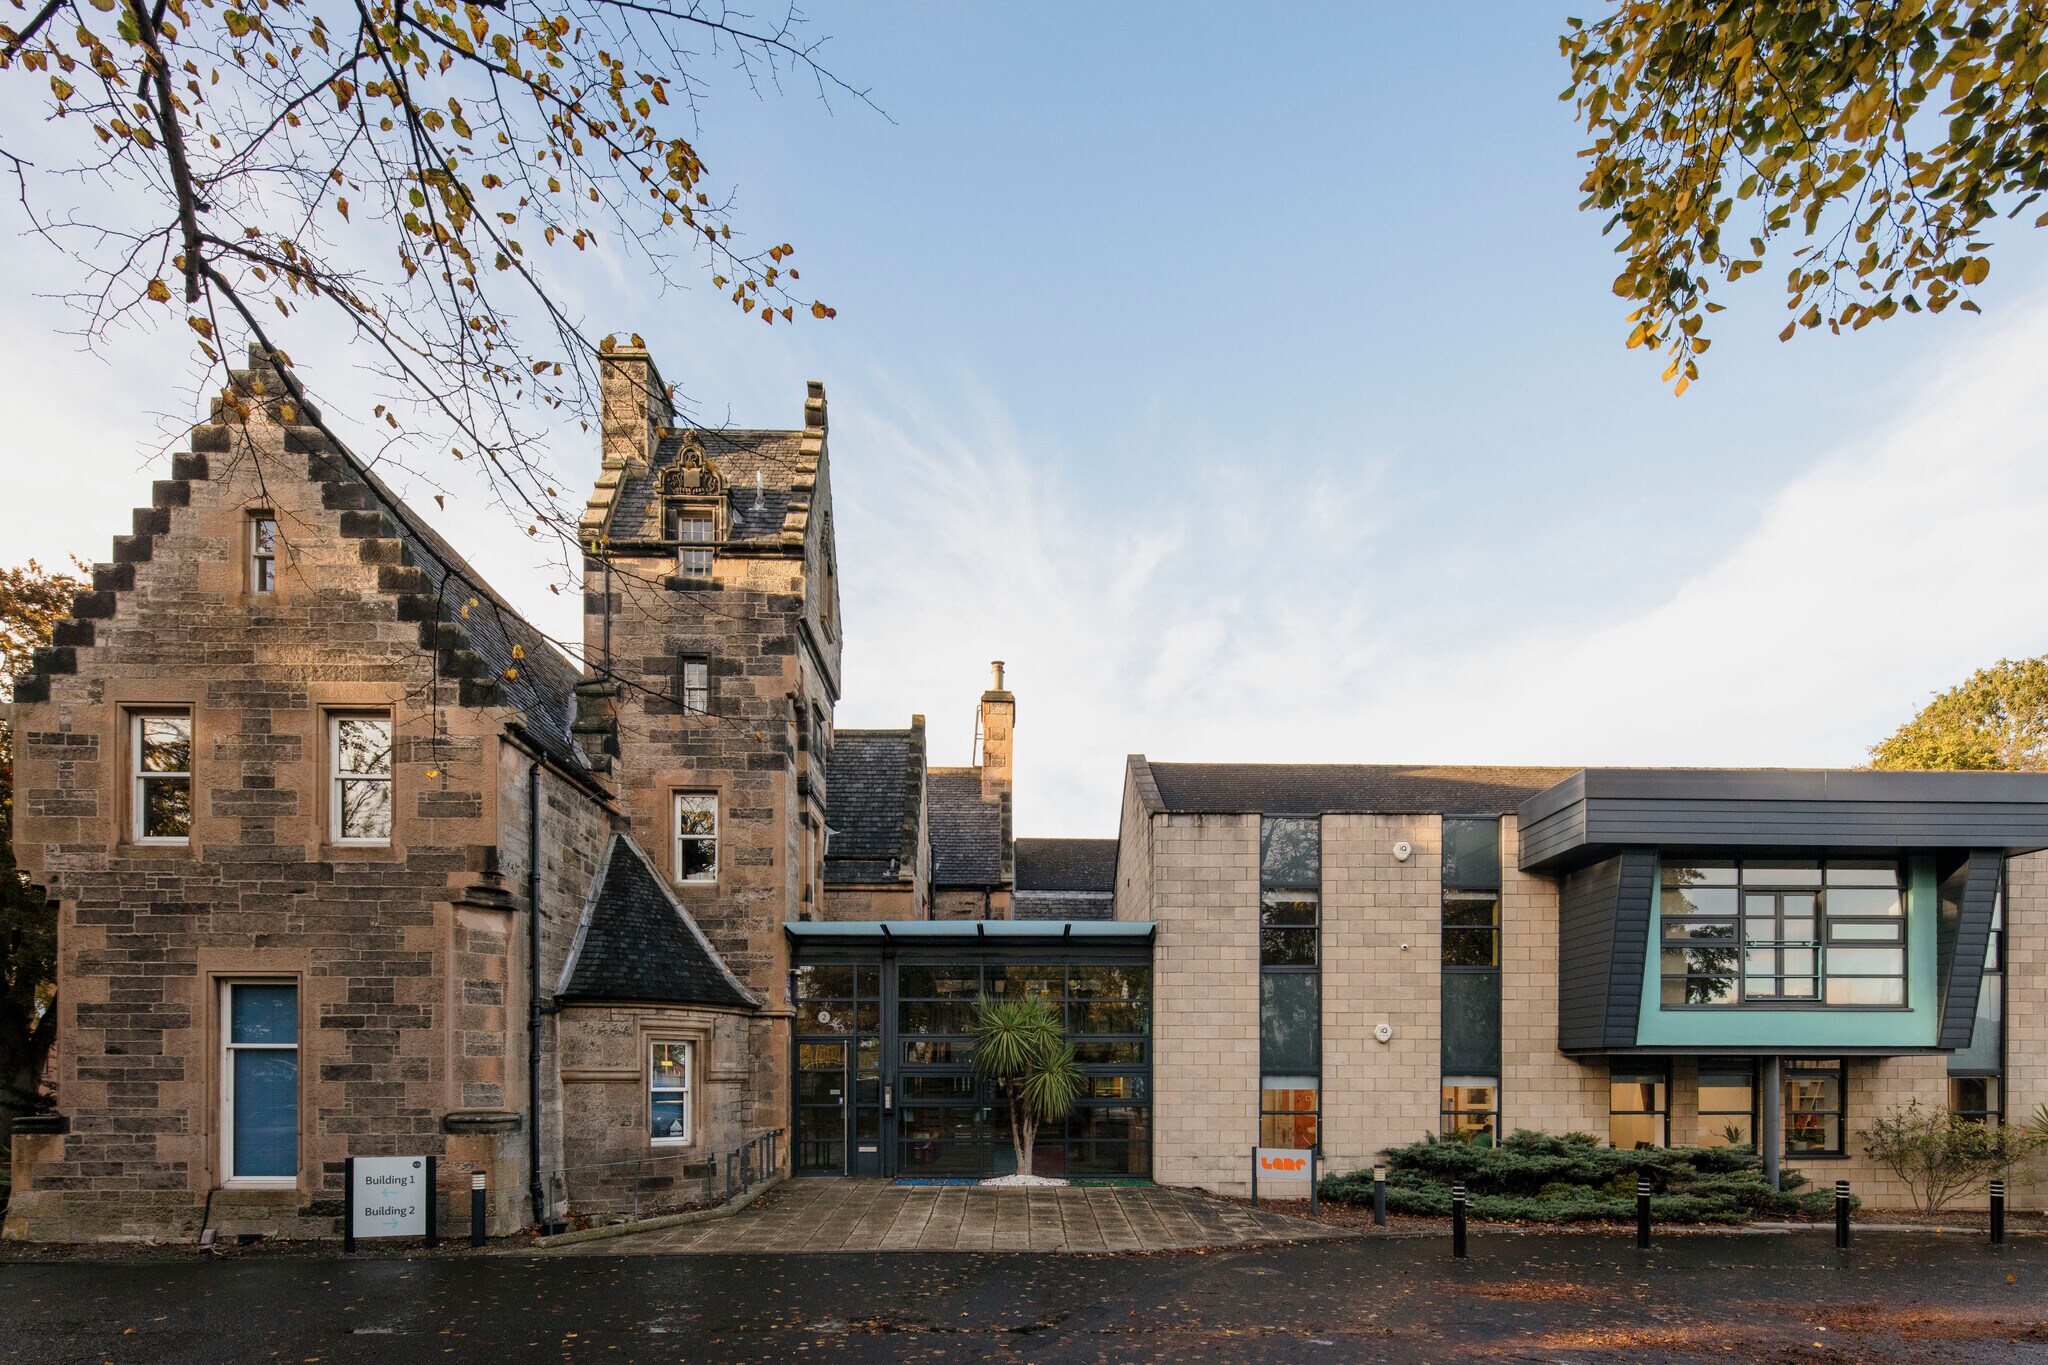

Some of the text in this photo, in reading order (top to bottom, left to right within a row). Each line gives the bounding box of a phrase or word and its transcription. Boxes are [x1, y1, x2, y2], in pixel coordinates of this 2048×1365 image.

[365, 1175, 415, 1186] Building 1
[365, 1206, 415, 1217] Building 2
